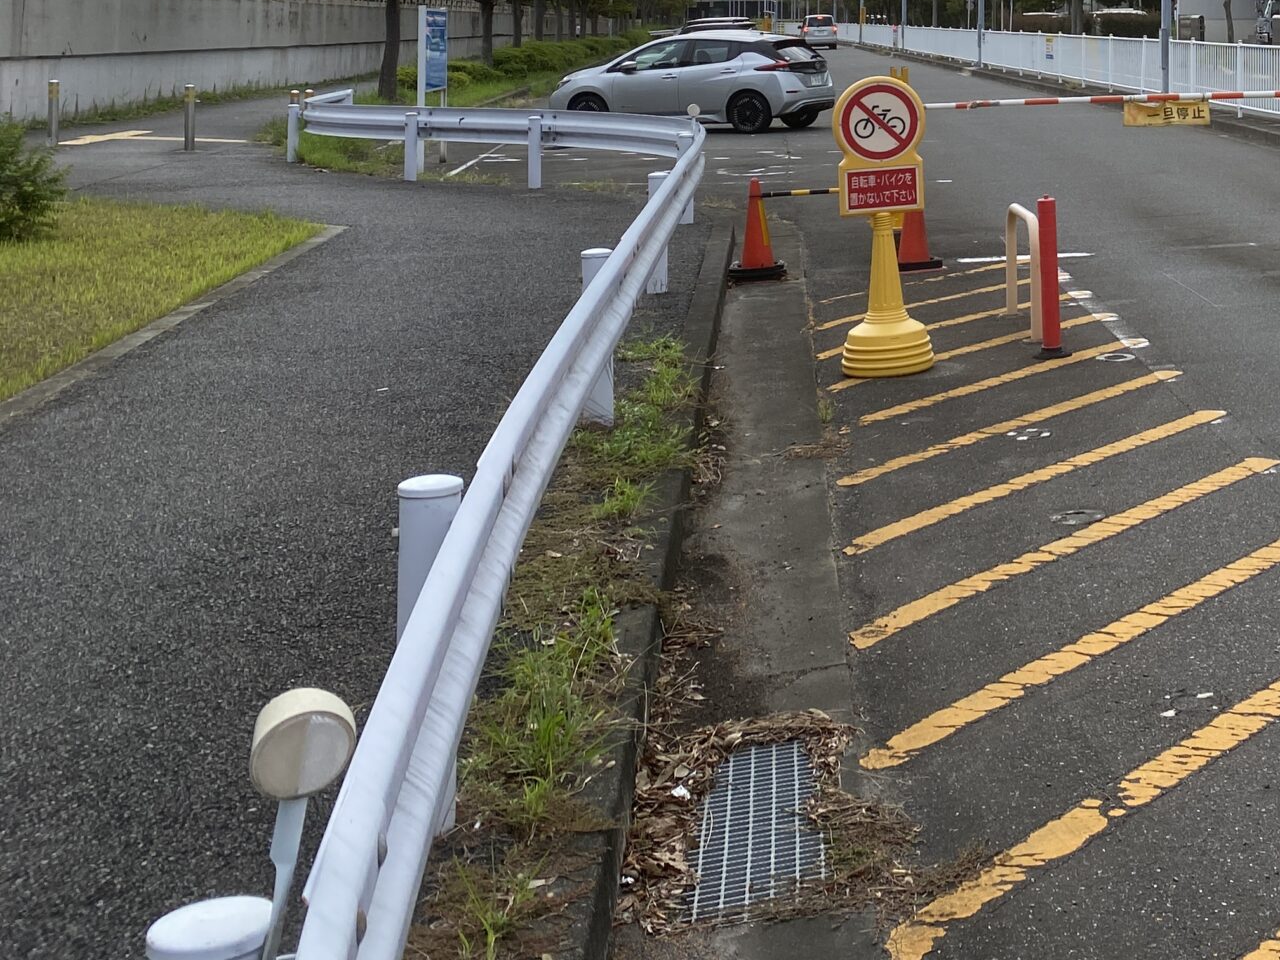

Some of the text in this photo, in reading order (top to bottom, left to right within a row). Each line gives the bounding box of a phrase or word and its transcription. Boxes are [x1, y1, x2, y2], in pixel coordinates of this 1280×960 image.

[1146, 105, 1206, 121] 一旦停止
[851, 172, 913, 189] 自転車・バイクを
[849, 189, 916, 207] 置かないで下さい
